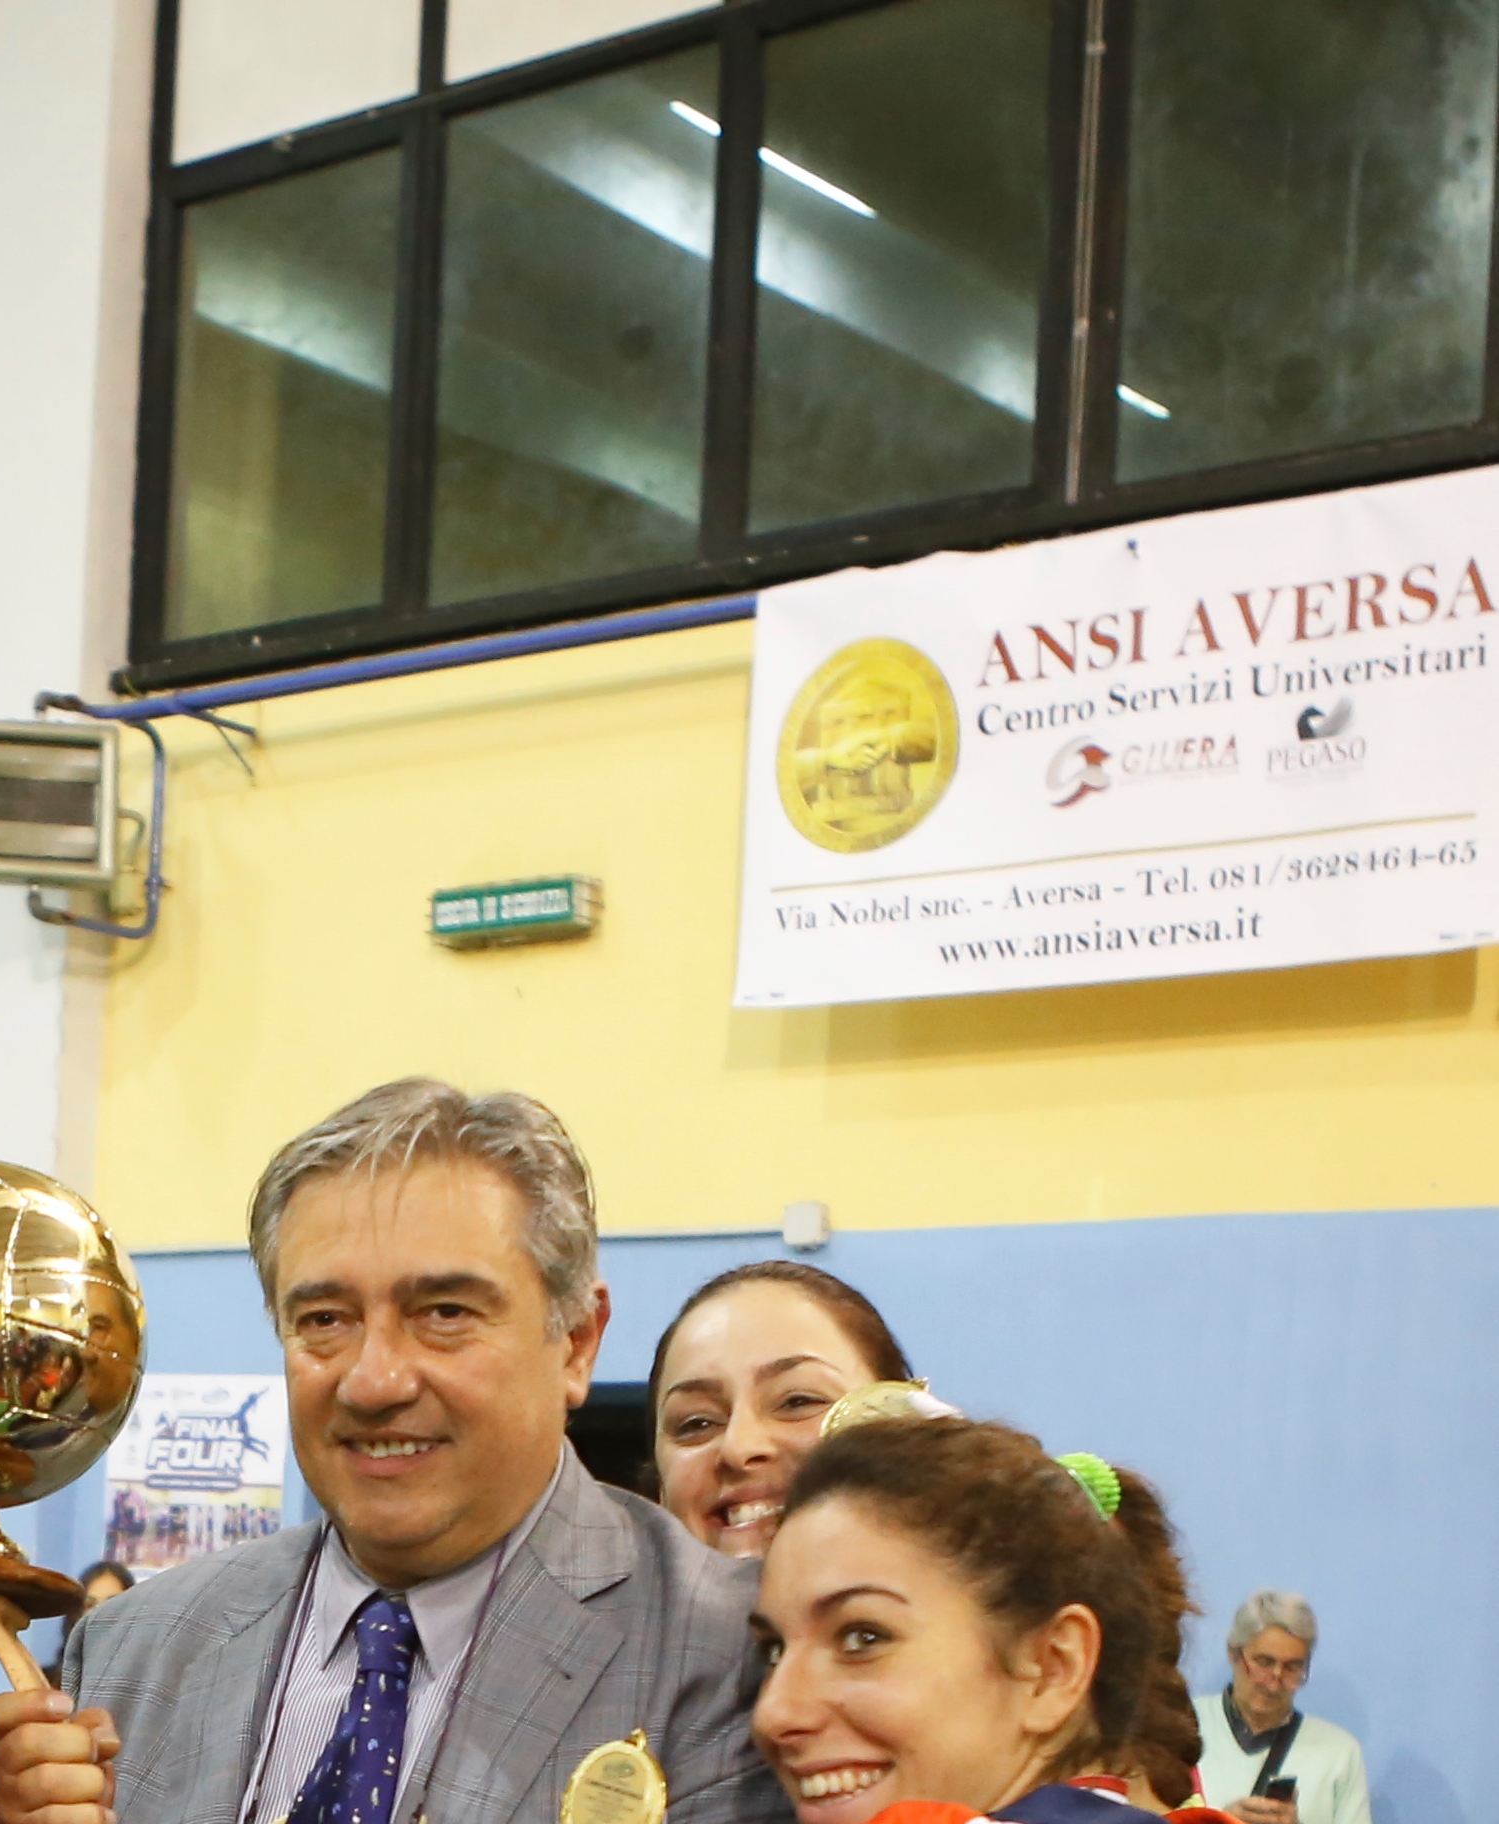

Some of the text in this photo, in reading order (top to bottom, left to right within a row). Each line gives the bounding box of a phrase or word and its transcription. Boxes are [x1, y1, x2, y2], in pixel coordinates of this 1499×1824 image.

[976, 556, 1499, 687] ANSI AVERSA
[977, 633, 1488, 736] Centro Servizi Universitari
[1266, 737, 1367, 773] PEGASO
[776, 905, 817, 932] Via
[829, 895, 911, 928] Nobel
[920, 895, 971, 919] snc.
[1003, 882, 1102, 911] Aversa
[1137, 866, 1198, 898] Tel.
[939, 906, 1263, 967] www.ansiaversa.it
[146, 1437, 244, 1470] FOUR
[176, 1416, 244, 1440] FINAL
